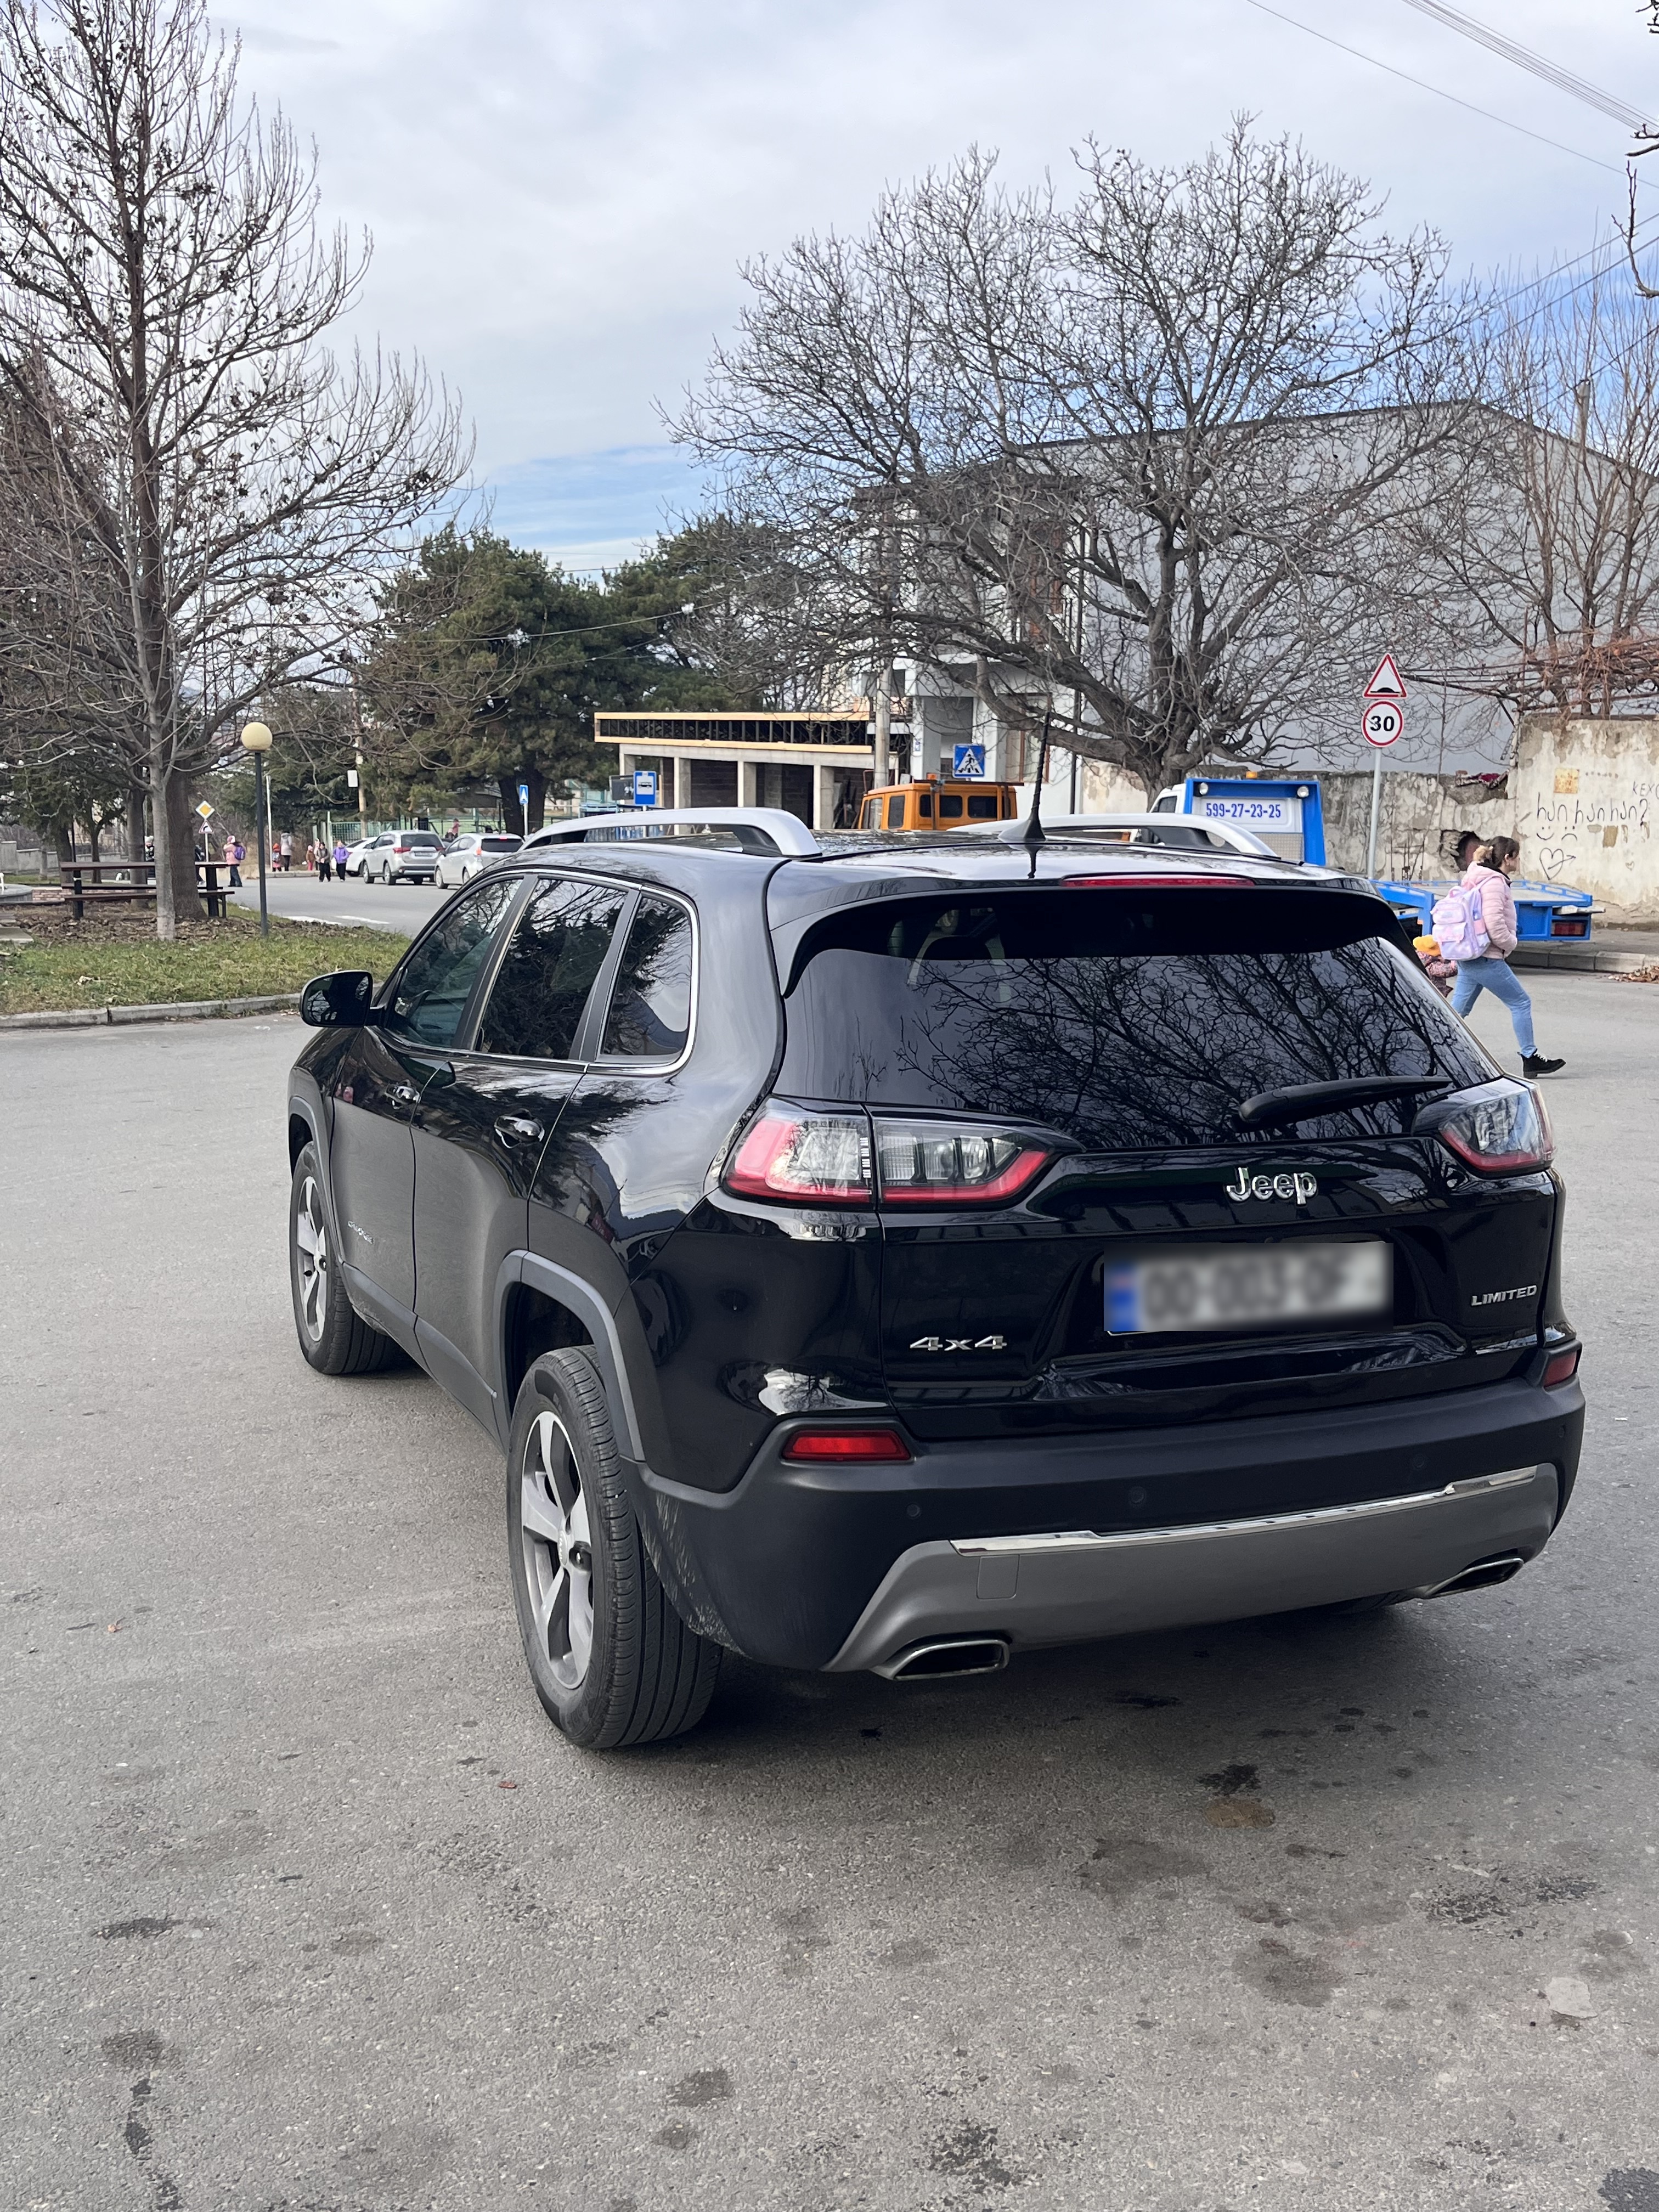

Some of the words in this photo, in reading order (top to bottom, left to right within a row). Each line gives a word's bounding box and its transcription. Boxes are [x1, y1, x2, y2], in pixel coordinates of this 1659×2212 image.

[1370, 715, 1395, 732] 30
[1206, 803, 1282, 818] 599-27-23-25
[1226, 1166, 1317, 1205] Jeep
[1471, 1285, 1537, 1306] LIMITED
[910, 1335, 1008, 1351] 4x4
